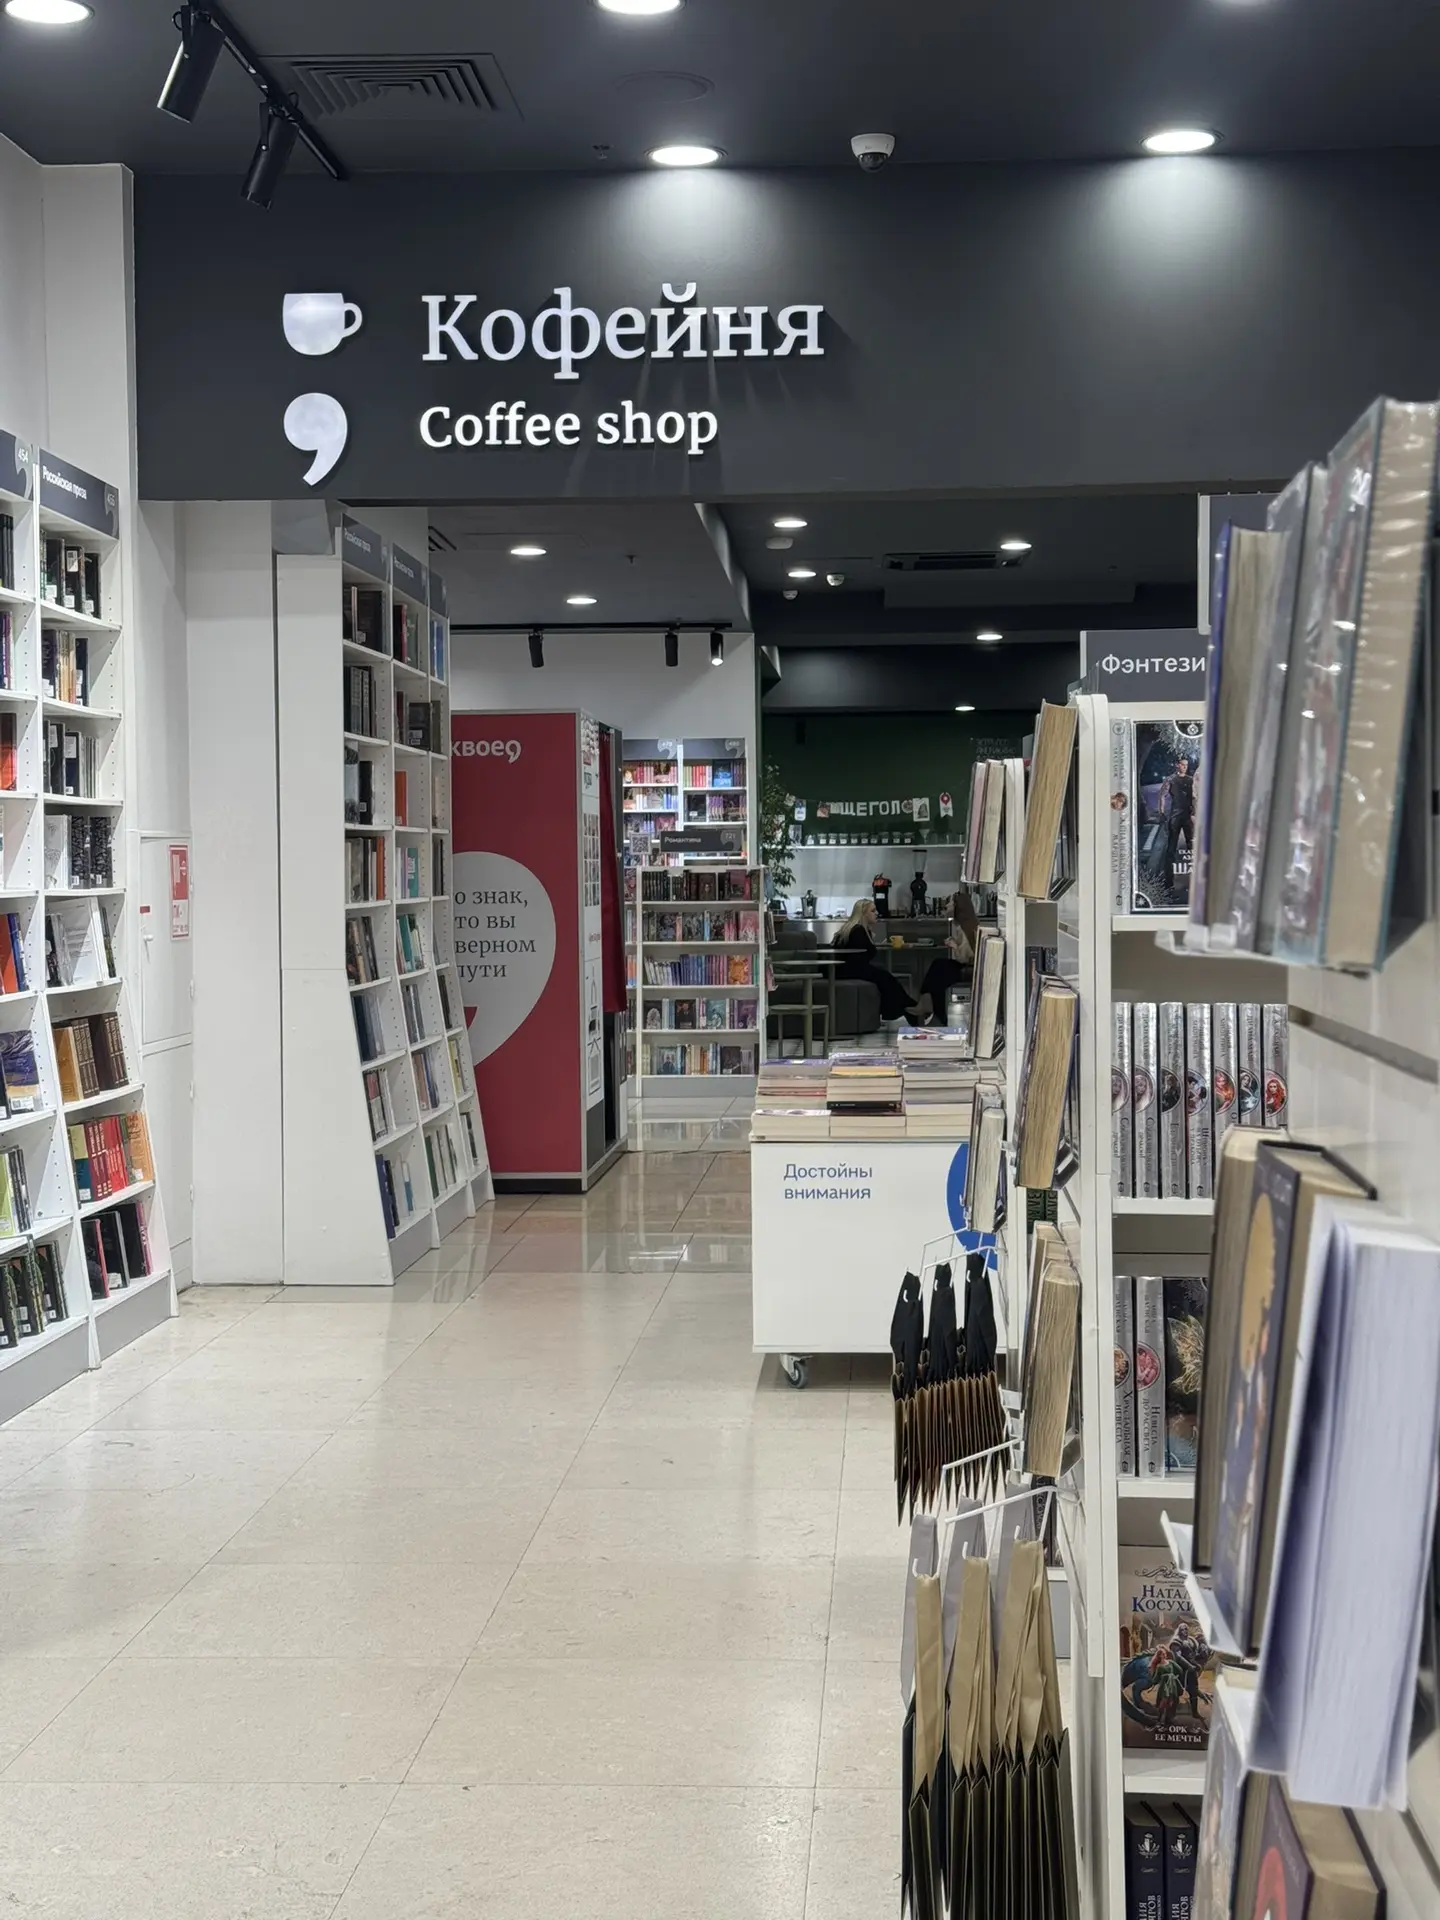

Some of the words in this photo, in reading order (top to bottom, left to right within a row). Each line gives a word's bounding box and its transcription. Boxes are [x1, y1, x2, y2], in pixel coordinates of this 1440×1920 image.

[421, 283, 825, 379] Кофейня
[419, 401, 581, 448] Coffee
[597, 400, 718, 455] shop
[1102, 654, 1206, 674] Фэнтези
[472, 891, 528, 908] знак,
[487, 916, 516, 929] вы
[455, 939, 537, 958] верном
[784, 1162, 873, 1181] Достойны
[784, 1188, 871, 1200] внимания
[1167, 1734, 1201, 1742] МЕЧТЫ
